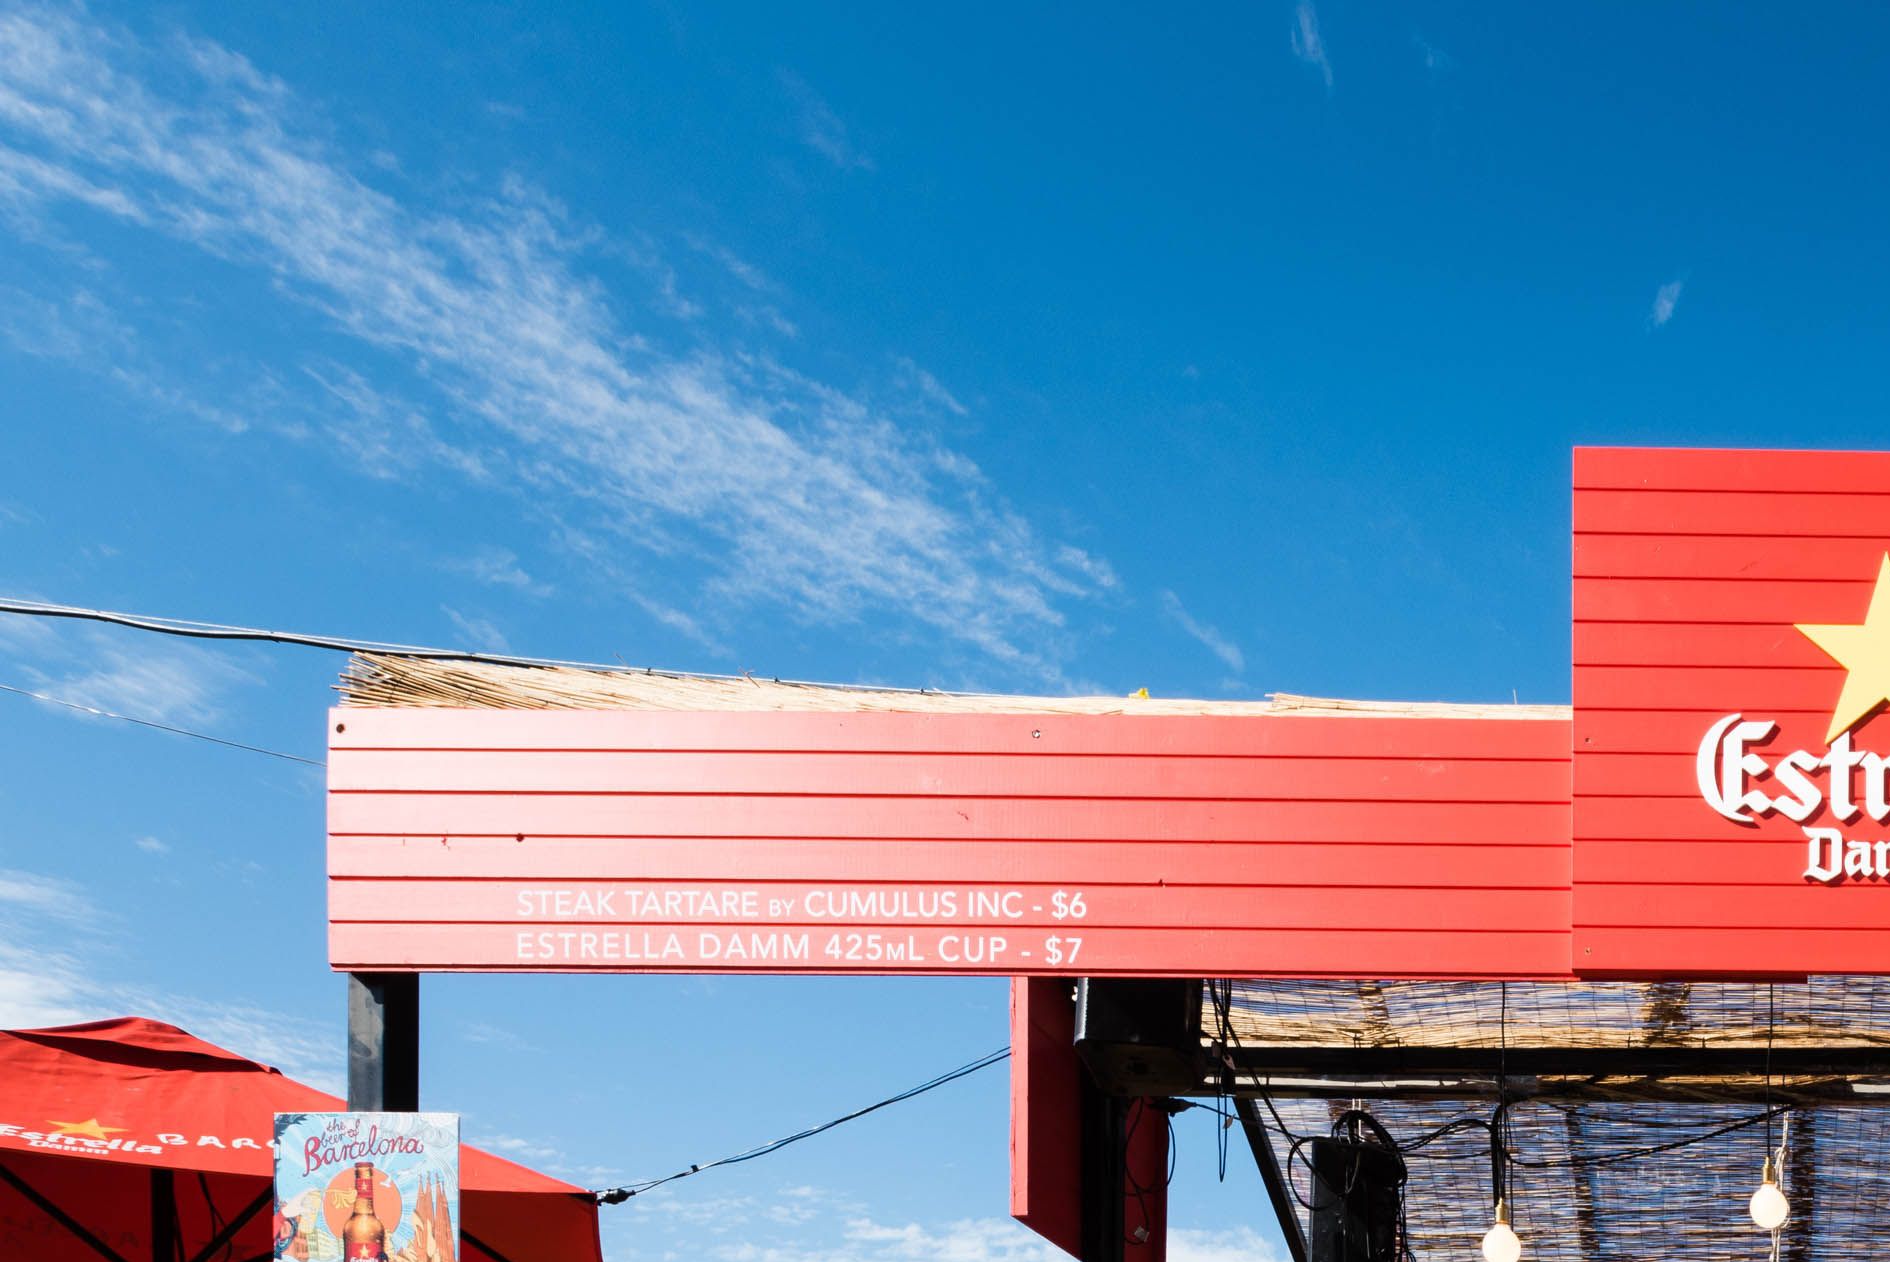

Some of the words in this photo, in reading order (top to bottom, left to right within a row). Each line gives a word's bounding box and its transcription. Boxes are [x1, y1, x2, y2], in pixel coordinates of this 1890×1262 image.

[517, 891, 615, 916] STEAK
[624, 892, 757, 916] TARTARE
[769, 900, 794, 914] BY
[805, 892, 956, 917] CUMULUS
[969, 892, 1024, 918] INC
[1051, 891, 1087, 920] $6
[517, 933, 684, 959] ESTRELLA
[700, 934, 809, 960] DAMM
[938, 936, 1007, 962] CUP
[1045, 936, 1082, 965] $7
[327, 1118, 346, 1132] the
[303, 1125, 424, 1177] Barcelona
[320, 1132, 345, 1148] beer
